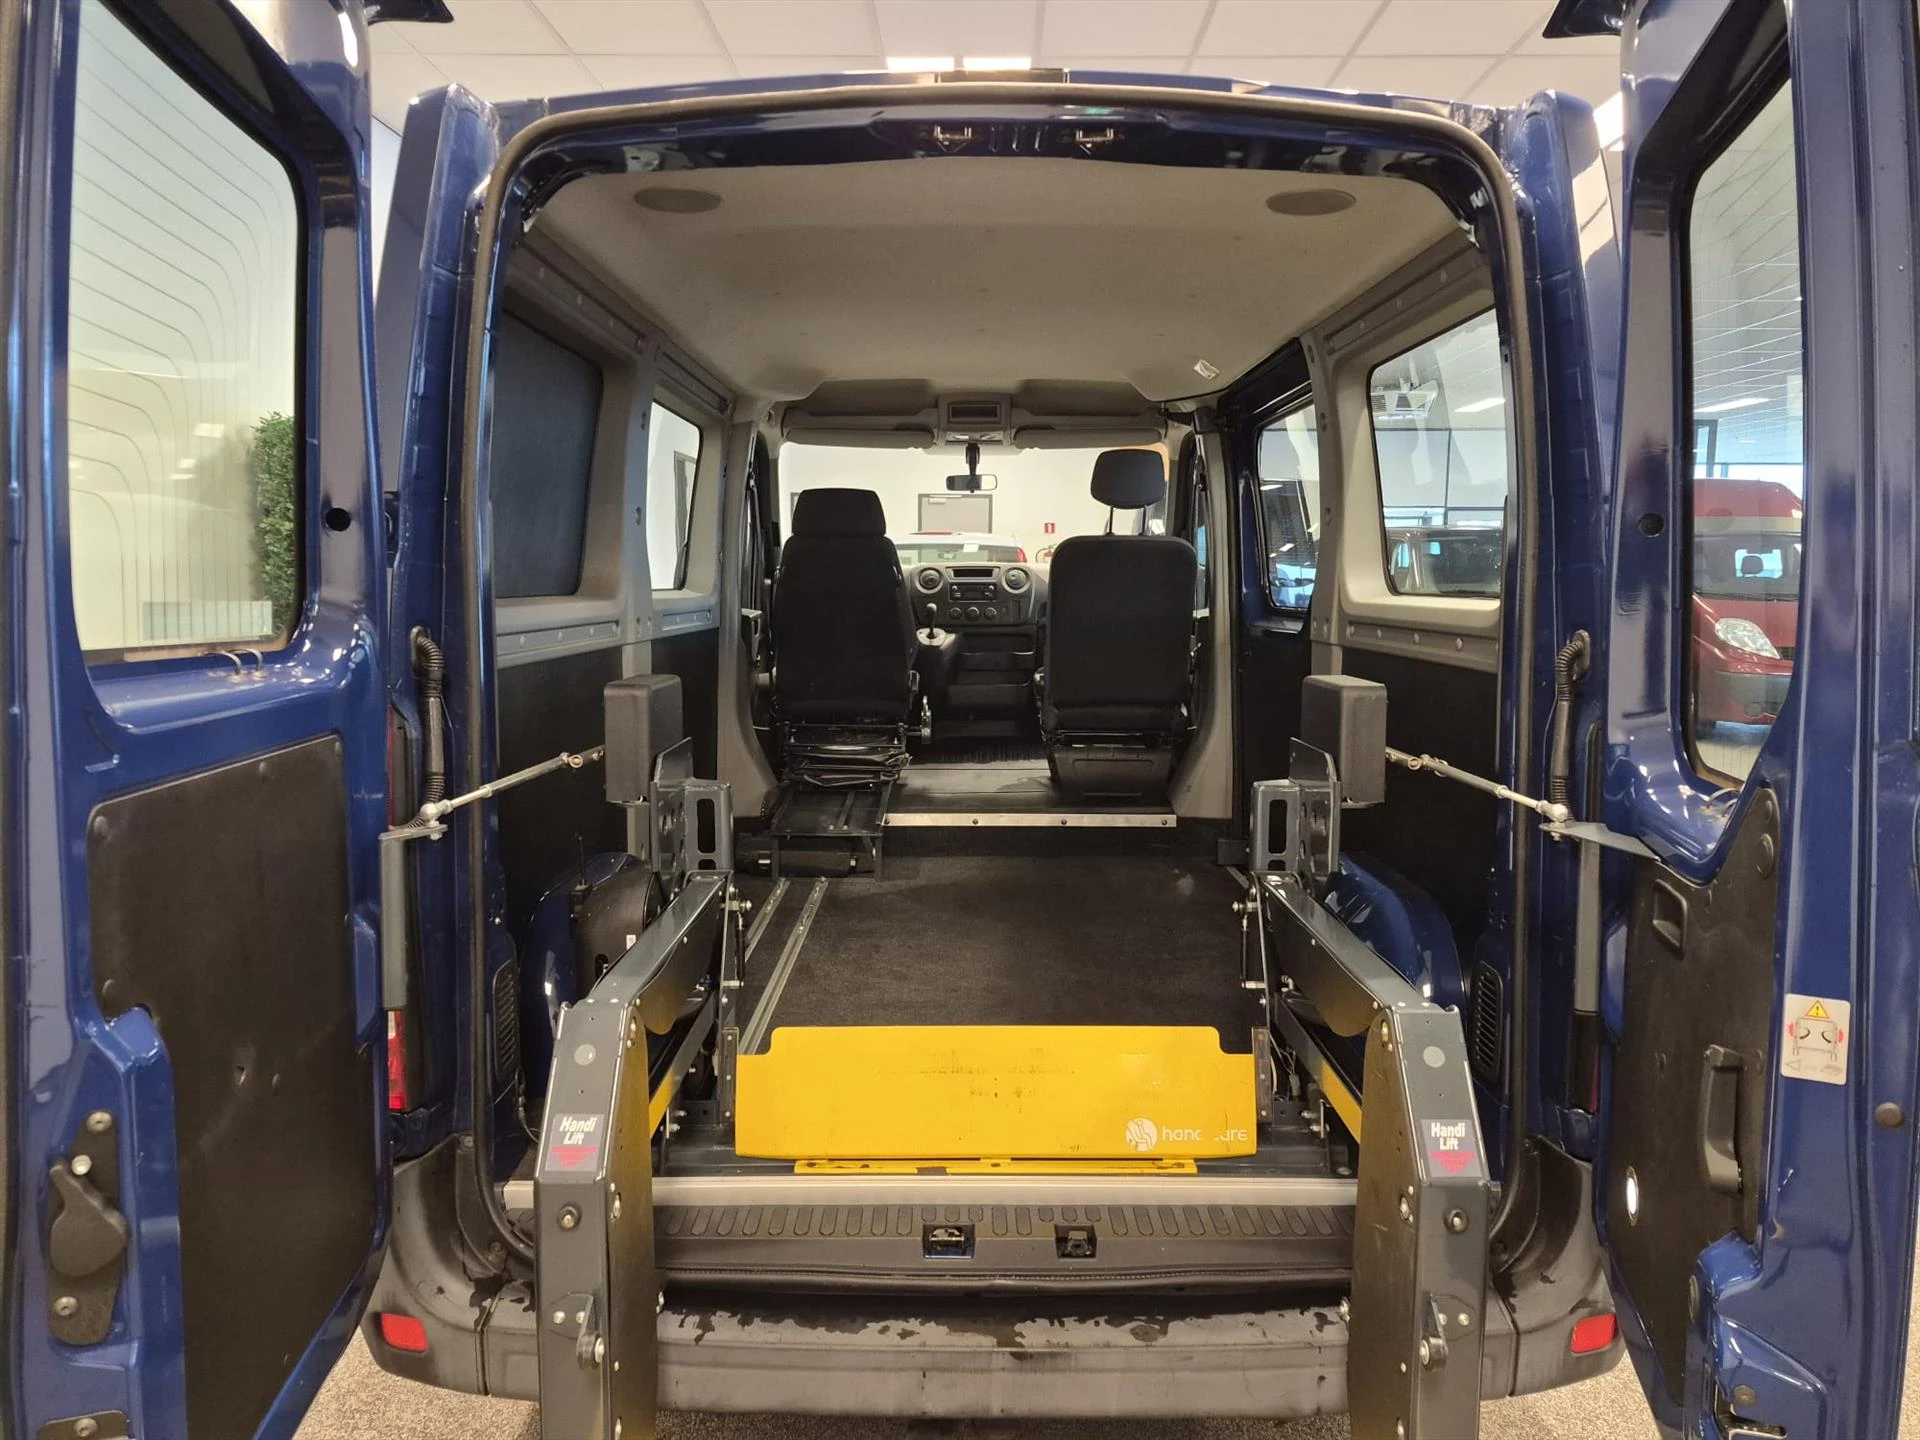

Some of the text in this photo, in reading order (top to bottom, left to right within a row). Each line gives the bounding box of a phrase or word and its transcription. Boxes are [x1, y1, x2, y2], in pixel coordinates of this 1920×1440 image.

[560, 1116, 597, 1132] Handi
[1431, 1122, 1466, 1138] Handi
[563, 1132, 585, 1145] Lift
[1161, 1126, 1248, 1142] hanare
[1439, 1137, 1459, 1151] Lift
